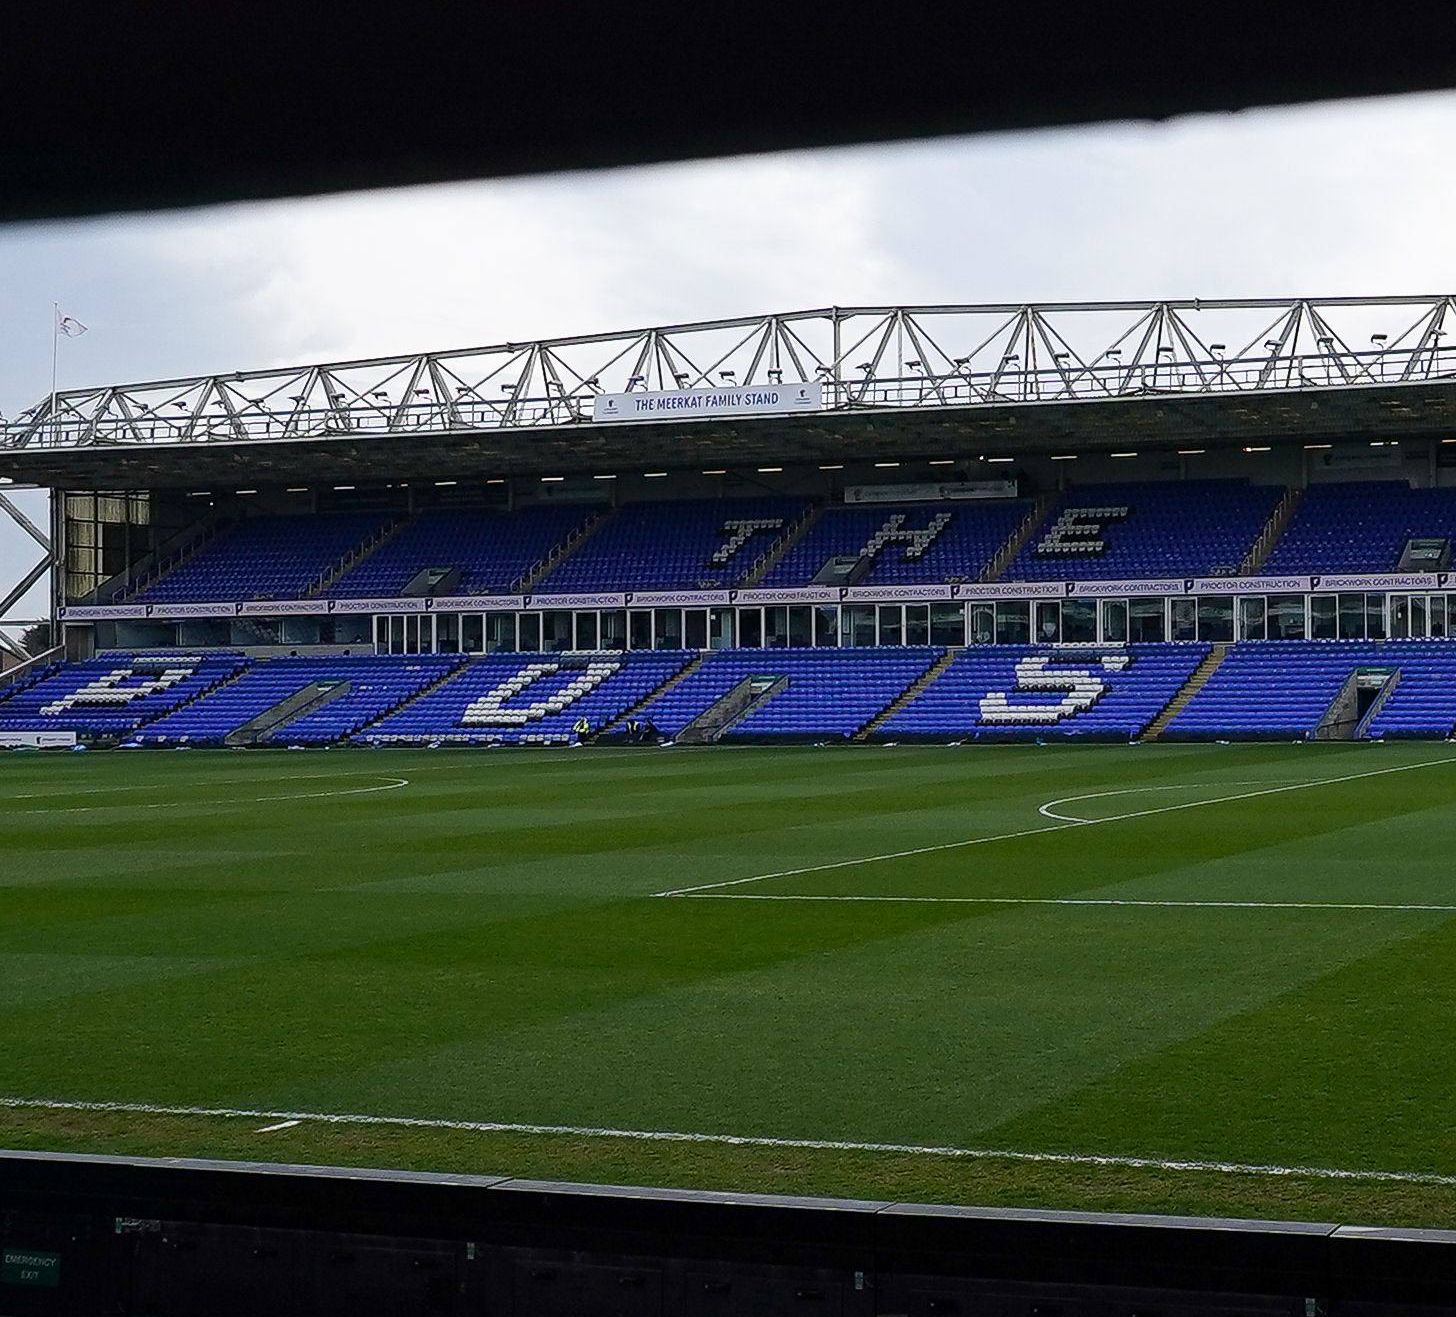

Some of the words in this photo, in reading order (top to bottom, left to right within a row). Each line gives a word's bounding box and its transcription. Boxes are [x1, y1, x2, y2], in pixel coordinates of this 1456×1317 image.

[635, 398, 655, 411] THE
[656, 396, 702, 410] MEERKAT
[705, 394, 743, 407] FAMILY
[744, 392, 779, 406] STAND
[1371, 576, 1432, 586] CONTRACTORS
[4, 1254, 57, 1268] EMERGENCY
[20, 1270, 40, 1280] EXIT
